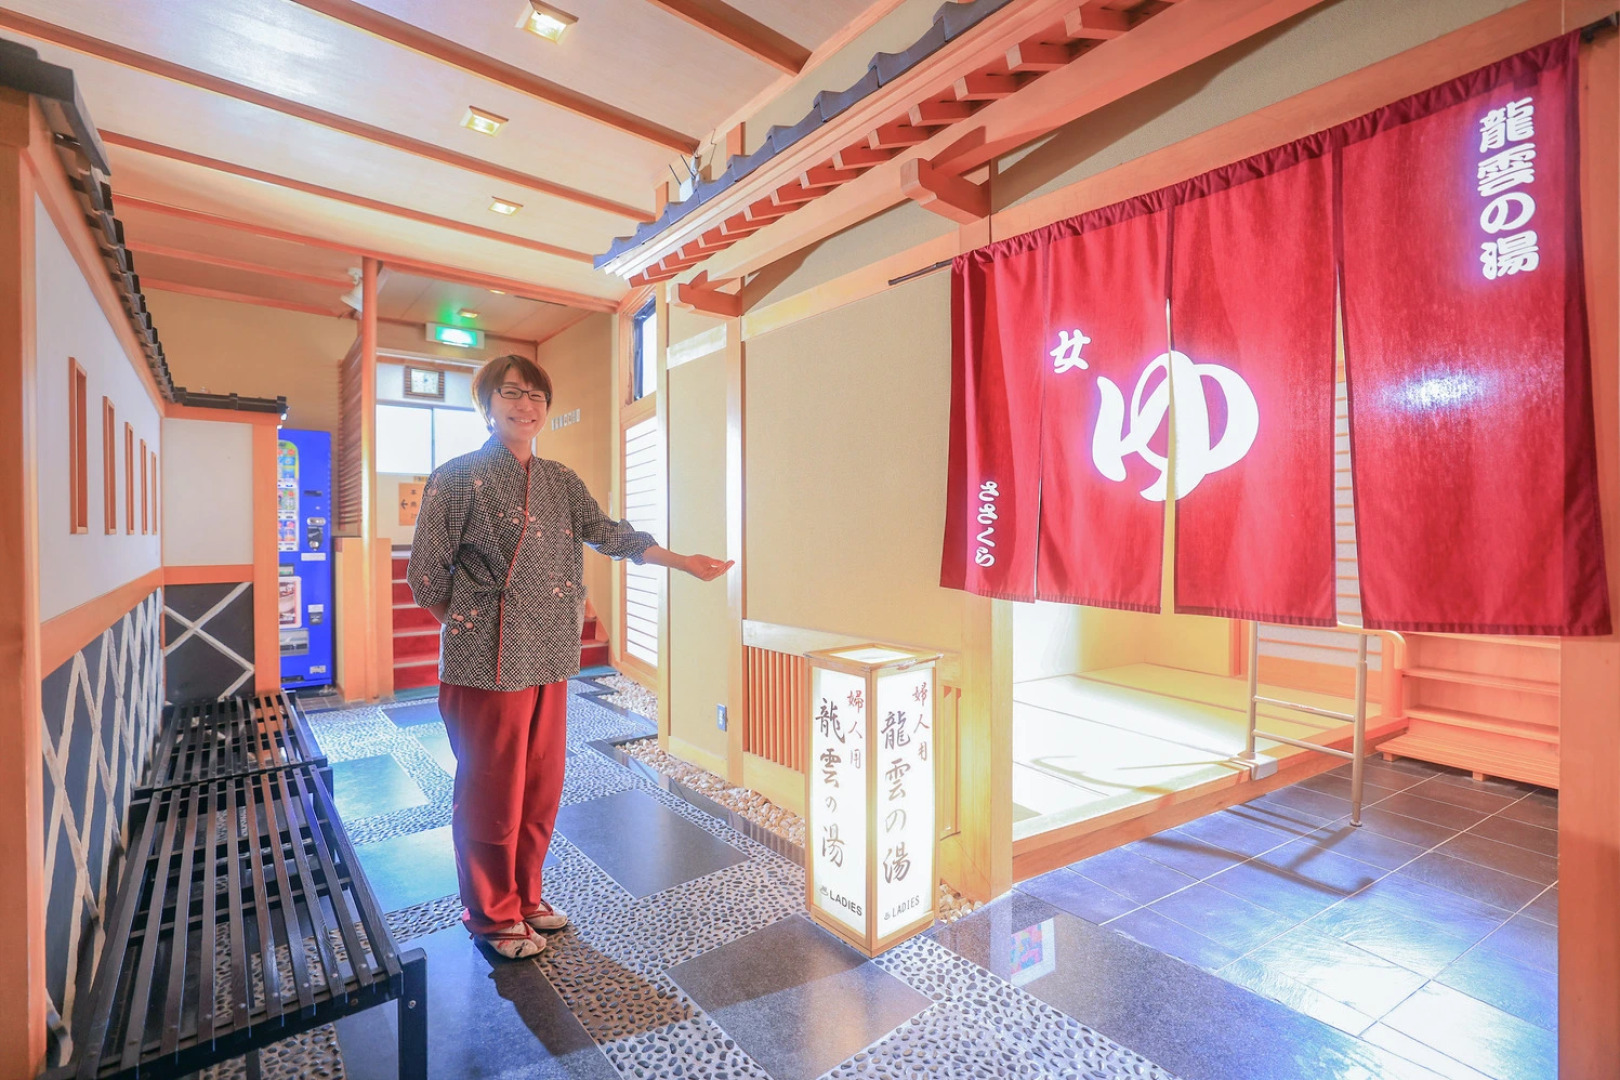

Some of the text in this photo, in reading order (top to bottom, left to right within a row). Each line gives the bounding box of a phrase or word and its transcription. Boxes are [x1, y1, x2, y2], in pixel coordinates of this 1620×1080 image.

[1477, 97, 1540, 280] 龍雲の湯
[1050, 329, 1091, 373] 女
[1092, 350, 1260, 502] ゆ
[975, 480, 1000, 567] ささくら
[847, 689, 864, 769] 婦人用
[912, 682, 930, 761] 婦人用
[815, 697, 846, 868] 龍雲の湯
[881, 710, 911, 884] 龍雲の湯
[829, 889, 863, 917] LADIES
[891, 895, 920, 918] LADIES
